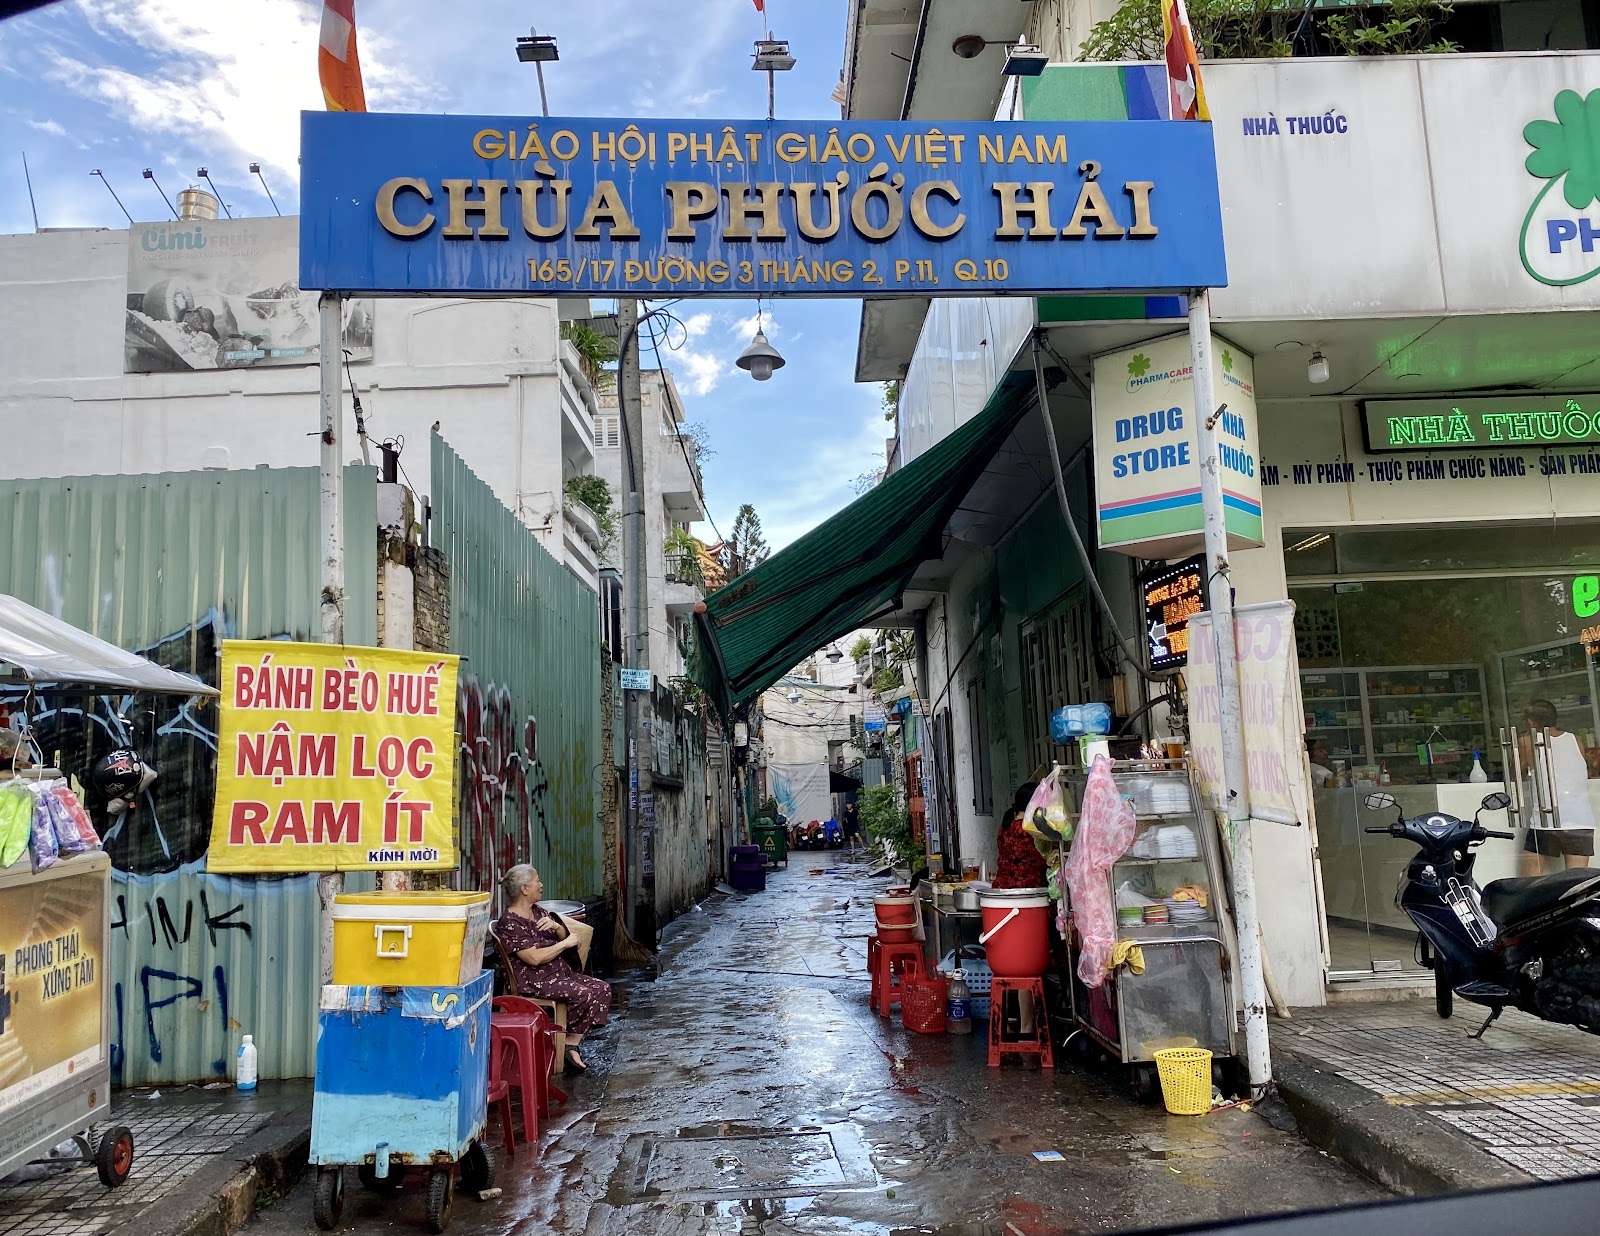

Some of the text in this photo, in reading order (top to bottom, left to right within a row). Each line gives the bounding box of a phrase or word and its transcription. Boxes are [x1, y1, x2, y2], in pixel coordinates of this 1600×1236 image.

[1242, 109, 1348, 136] NHÀ THUỐC
[472, 123, 1067, 169] GIÁO HỘI PHẬT GIÁO VIỆT NAM
[375, 159, 1159, 242] CHÙA PHƯỚC HẢI
[141, 226, 206, 252] Cimi
[527, 255, 1009, 286] 165/17 ĐƯỜNG 3 THÁNG 2, P.11, Q.10
[1130, 366, 1194, 387] PHARMACARE
[1115, 407, 1183, 443] DRUG
[1222, 410, 1246, 441] NHÀ
[1387, 407, 1476, 444] NHÀ
[1112, 441, 1190, 478] STORE
[1292, 460, 1312, 485] MỸ
[1316, 455, 1355, 484] PHẨM
[1367, 458, 1403, 486] THỰC
[1407, 452, 1446, 481] PHẨM
[1449, 454, 1486, 480] CHỨC
[1489, 452, 1527, 478] NĂNG
[1538, 450, 1567, 476] SẢN
[235, 654, 445, 715] BÁNH BÈO HUẾ
[236, 722, 433, 786] NẬM LỌC
[229, 801, 361, 844] RAM
[383, 791, 432, 843] ÍT
[368, 849, 438, 862] KÍNH MỜI
[15, 928, 79, 975] PHONG THÁI
[43, 965, 71, 1000] XỨNG
